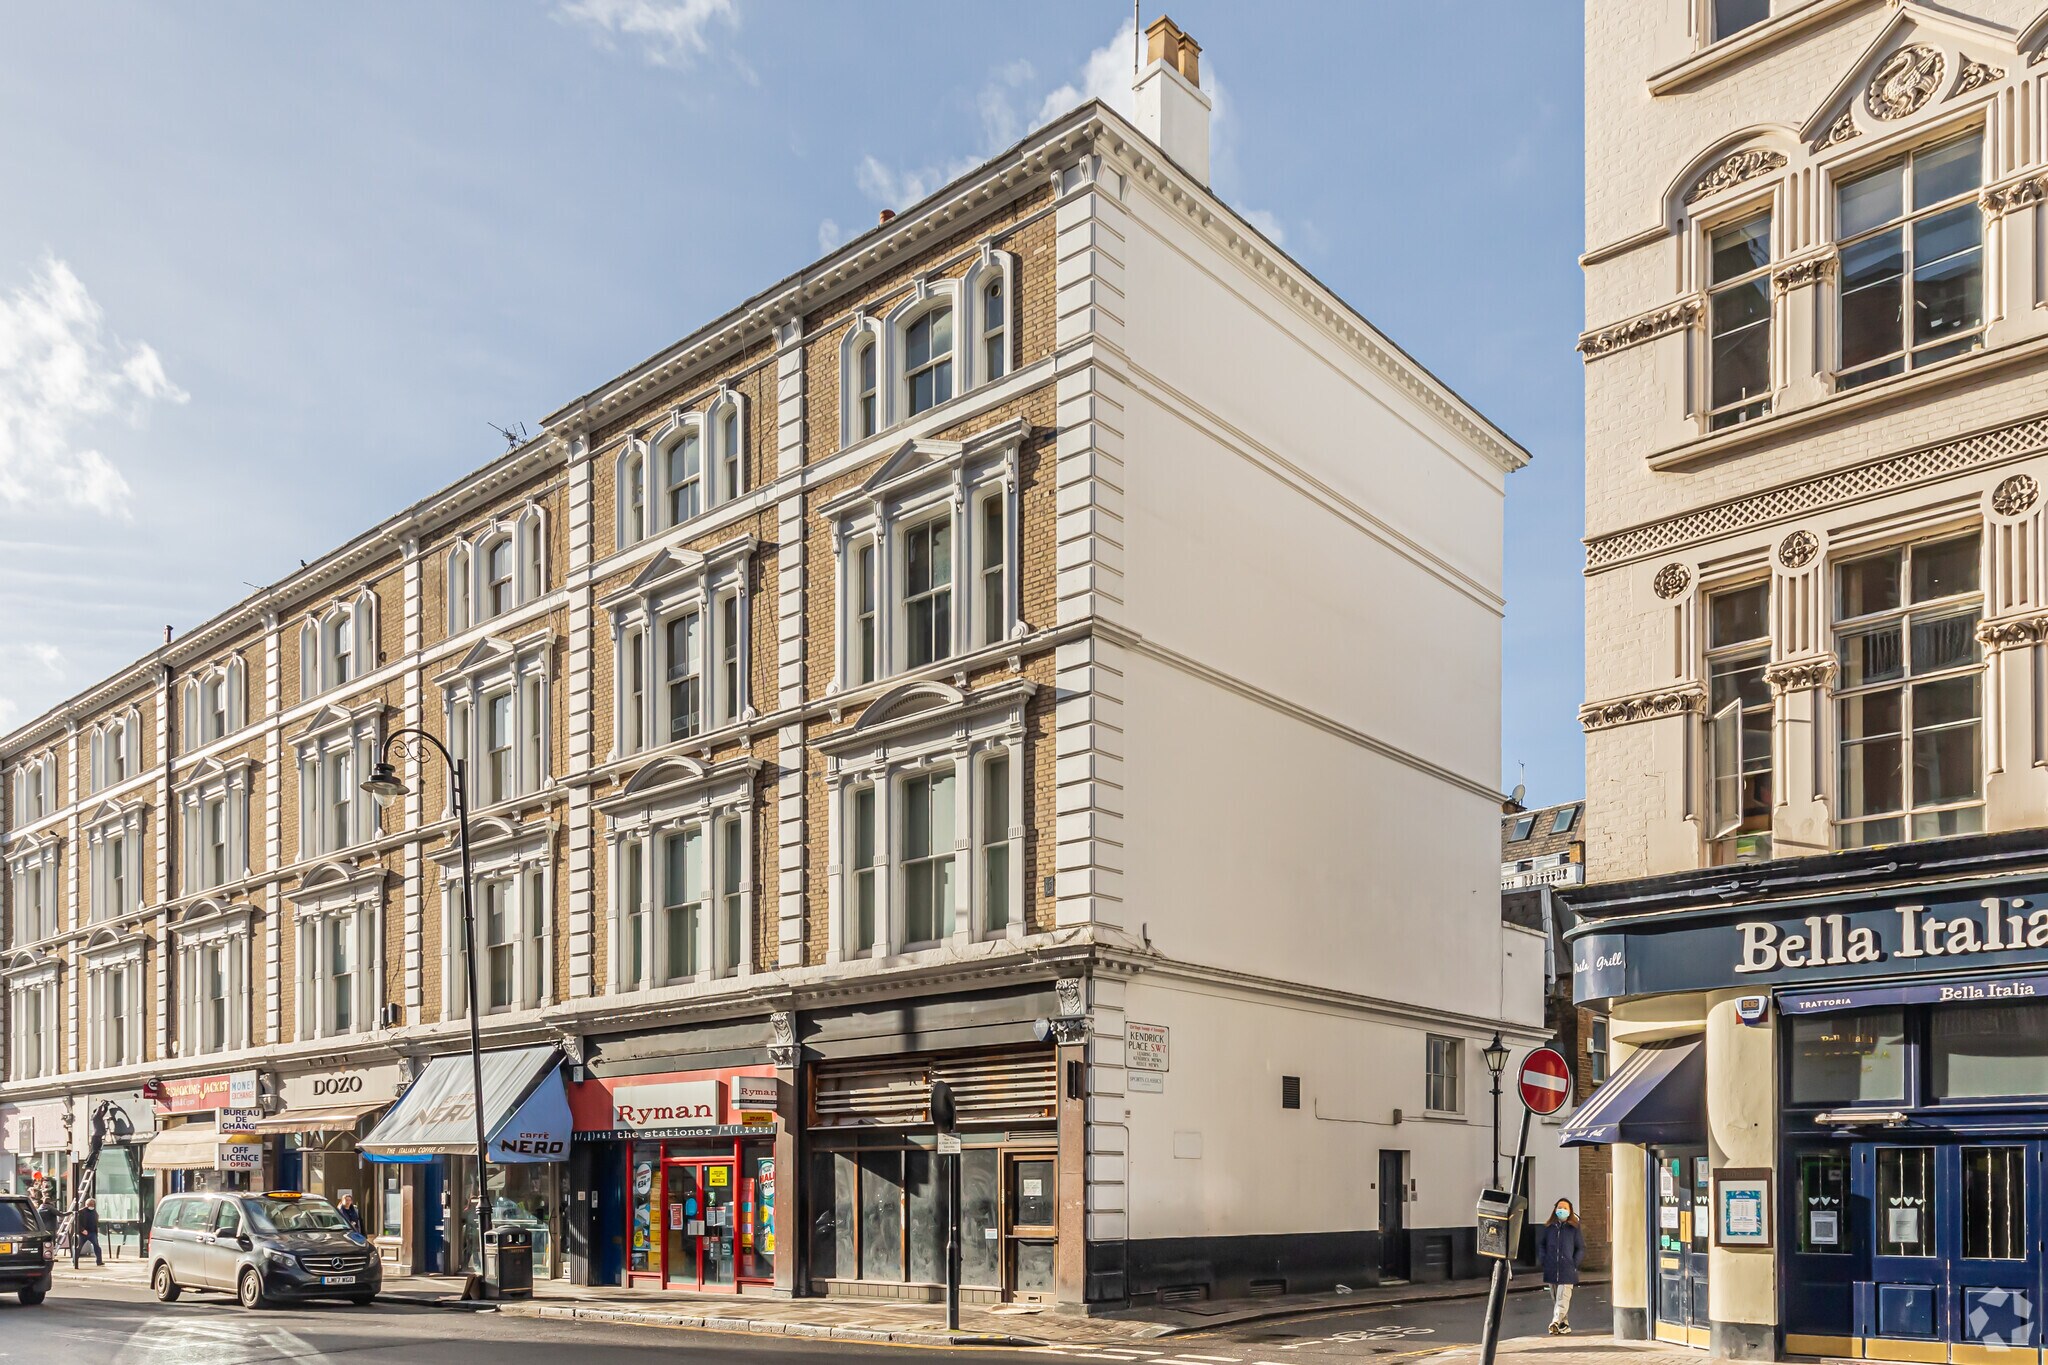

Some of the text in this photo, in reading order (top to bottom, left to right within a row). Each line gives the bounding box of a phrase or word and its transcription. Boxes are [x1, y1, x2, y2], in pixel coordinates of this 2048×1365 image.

[1734, 897, 2048, 973] Bella Italia
[1596, 951, 1623, 971] Grill
[1939, 982, 2035, 1001] Bella Italia
[1799, 998, 1852, 1009] TRATTORIA
[1130, 1031, 1165, 1044] KENDRICK
[199, 1080, 230, 1100] JACKET
[231, 1080, 255, 1091] MONEY
[313, 1075, 363, 1096] DOZO
[740, 1087, 777, 1097] Ryman
[223, 1108, 260, 1117] BUREAU
[408, 1103, 476, 1126] NERO
[616, 1103, 713, 1125] Ryman
[222, 1122, 257, 1130] CHANG
[617, 1130, 639, 1139] the
[644, 1127, 713, 1139] stationer
[232, 1146, 249, 1154] OFF
[417, 1146, 436, 1154] COFFEE
[501, 1139, 564, 1154] NERO
[221, 1153, 259, 1162] LICENCE
[760, 1171, 775, 1184] HAL
